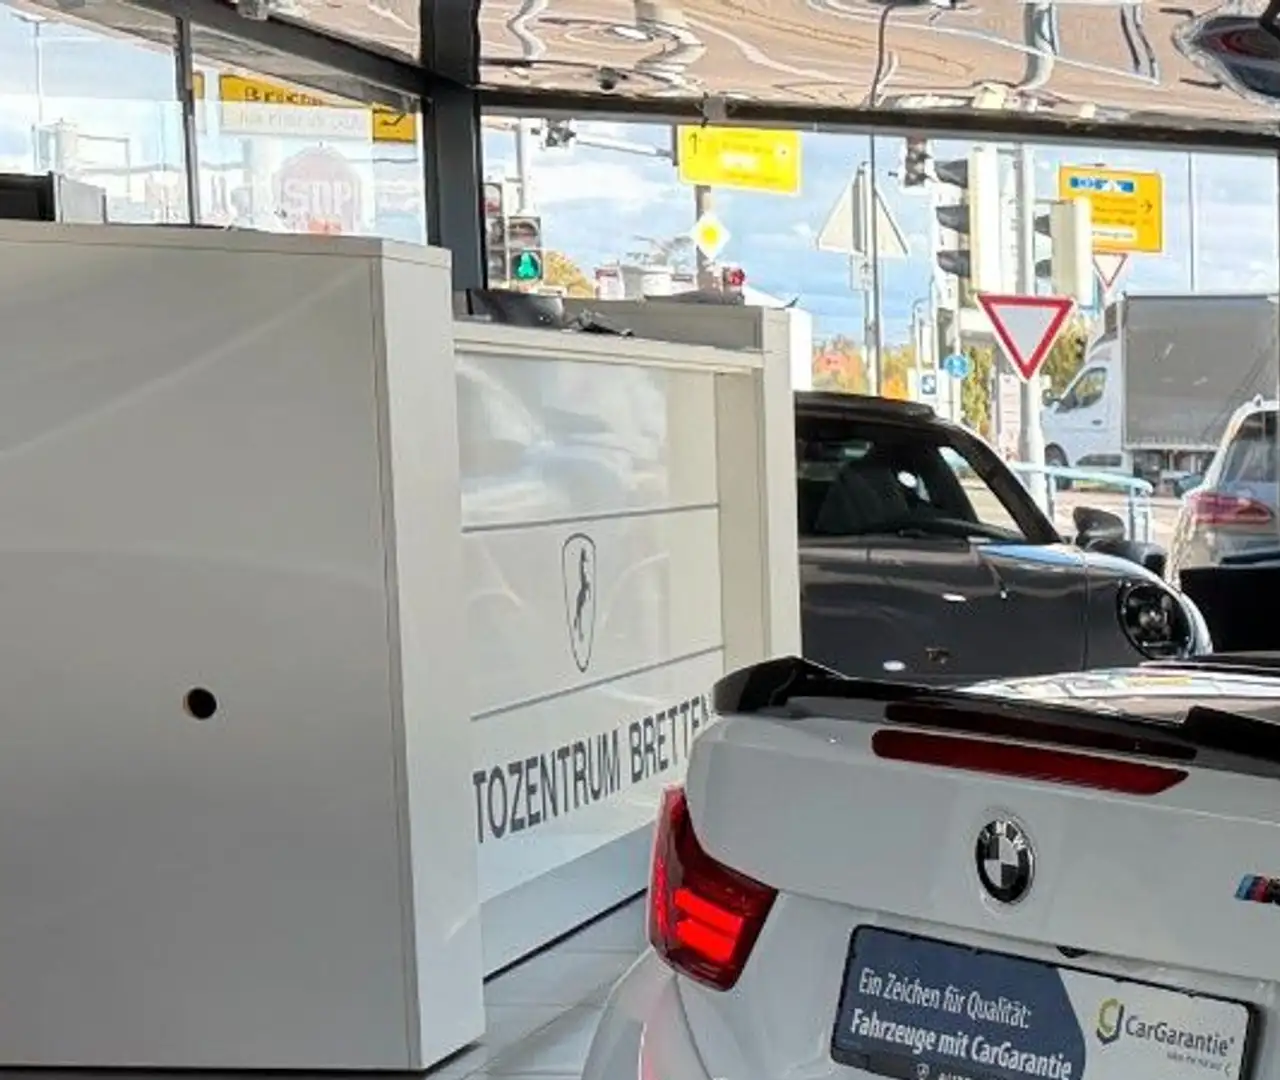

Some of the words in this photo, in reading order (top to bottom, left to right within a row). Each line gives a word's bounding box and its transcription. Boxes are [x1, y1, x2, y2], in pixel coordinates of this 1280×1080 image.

[472, 729, 622, 844] TOZENTRUM
[859, 966, 883, 996] Ein
[883, 972, 940, 1010] Zeichen
[942, 984, 966, 1013] für
[966, 989, 1032, 1030] Qualität:
[850, 1007, 937, 1055] Fahrzeuge
[937, 1031, 970, 1059] mit
